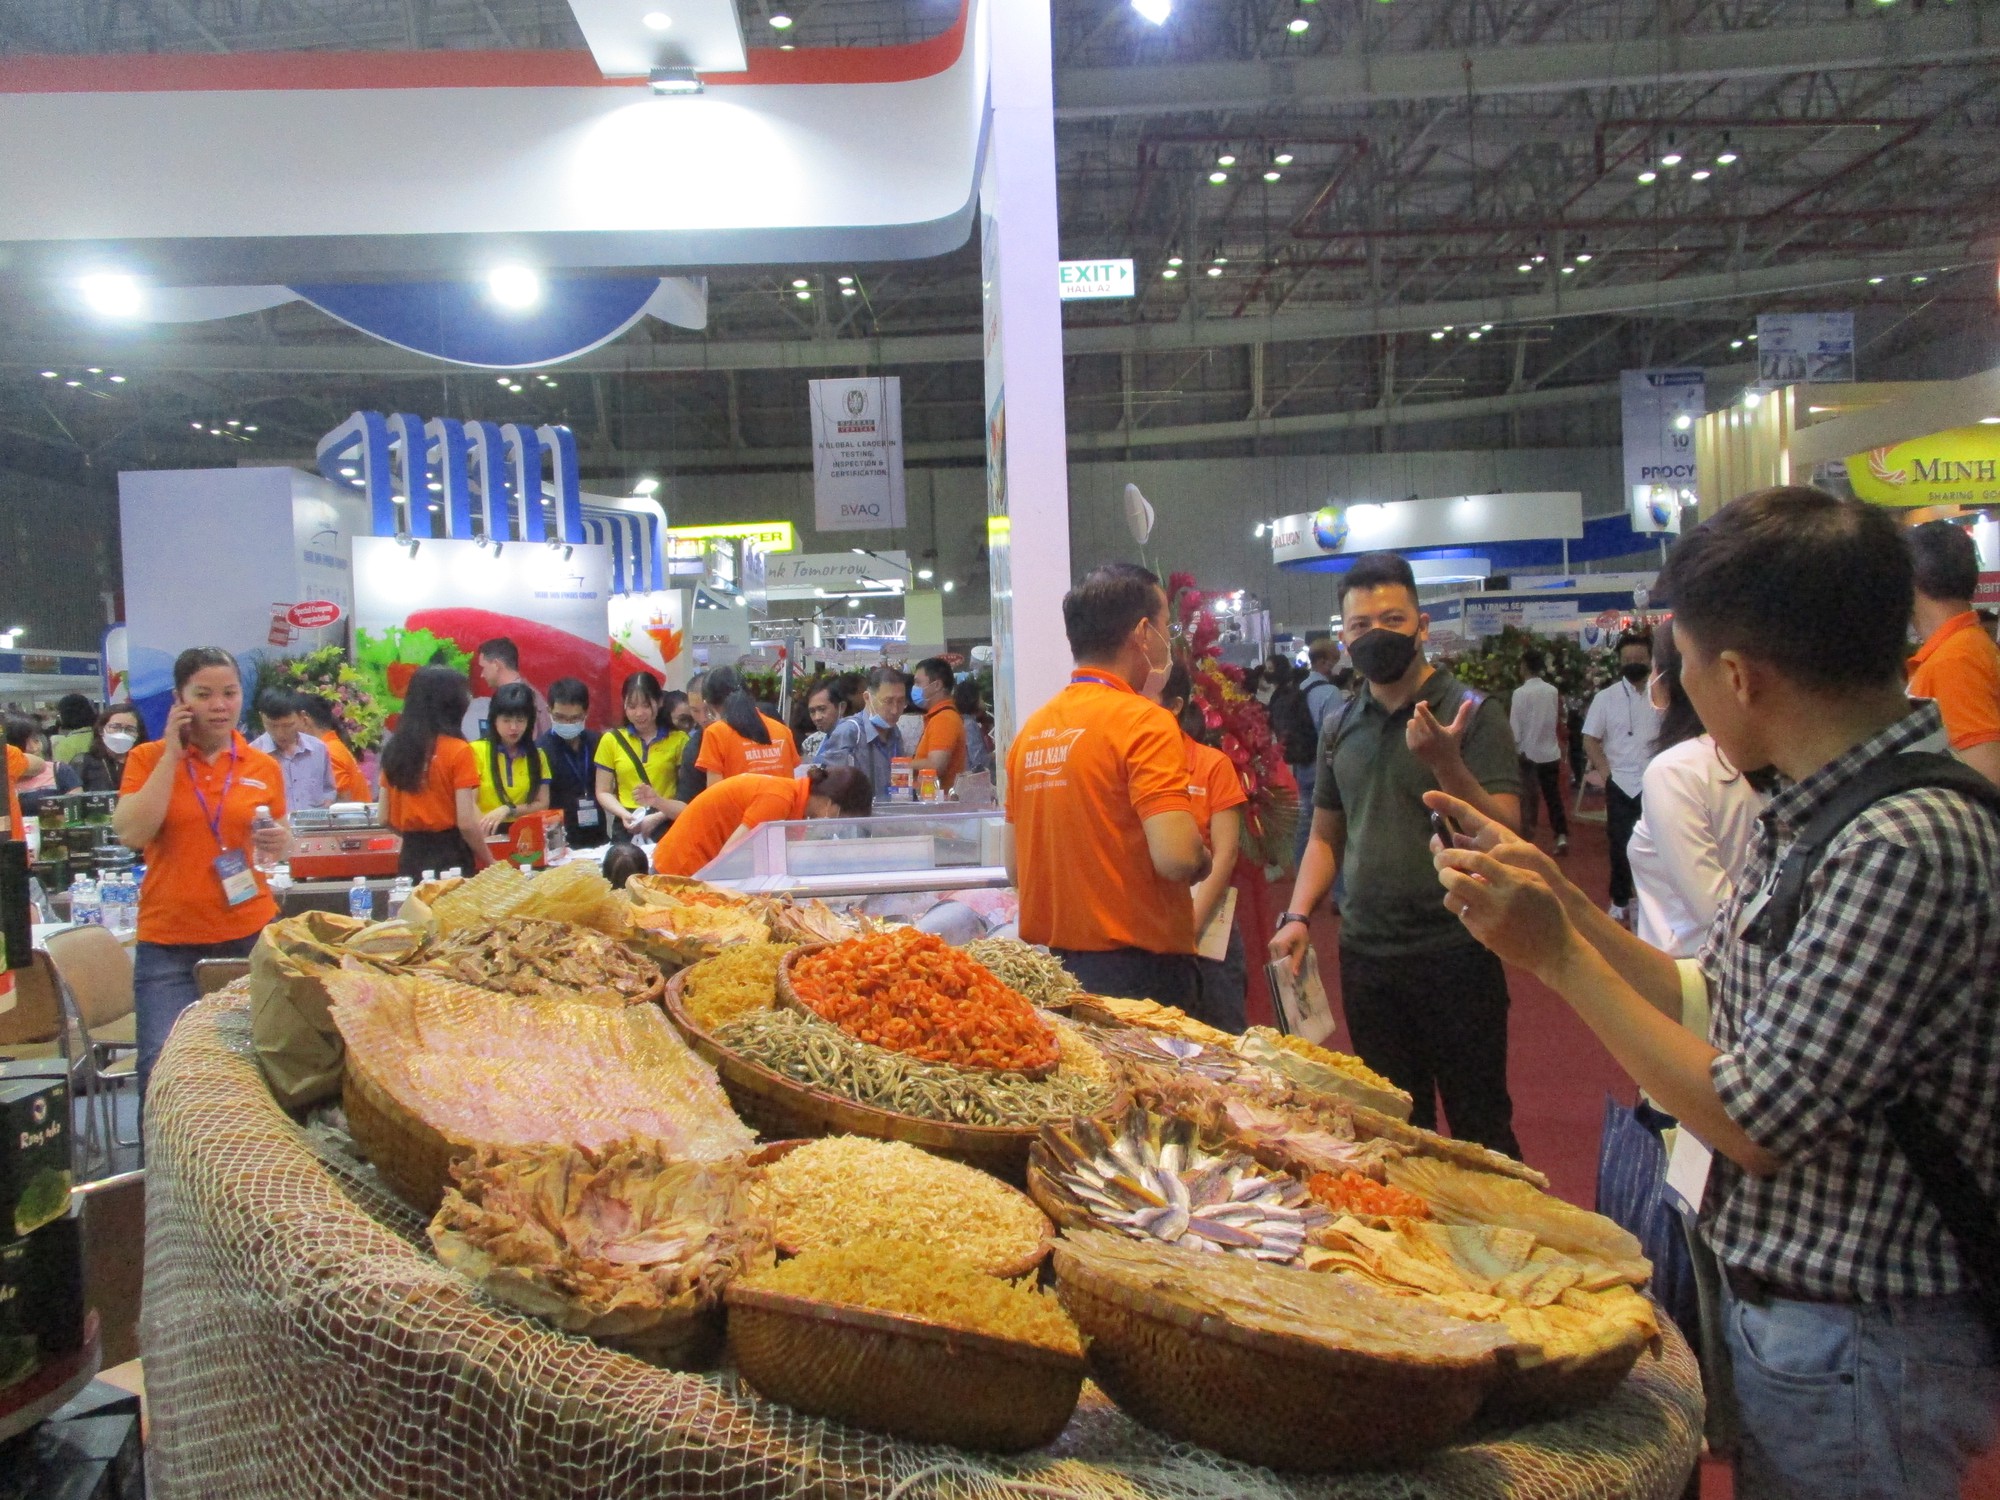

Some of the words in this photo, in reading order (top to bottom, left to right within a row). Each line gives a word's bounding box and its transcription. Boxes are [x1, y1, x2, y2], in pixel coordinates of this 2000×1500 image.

[1060, 265, 1114, 283] EXIT
[1067, 285, 1093, 293] HALL
[1097, 284, 1111, 292] A2
[826, 441, 855, 449] GLOBAL
[857, 440, 887, 448] LEADER
[833, 460, 877, 468] INSPECTION
[1911, 458, 1996, 483] MINH
[1929, 490, 1973, 501] SHARING
[841, 503, 880, 517] BVAQ
[793, 559, 870, 577] Tomorrow.
[1484, 602, 1506, 612] TRANG
[761, 747, 781, 759] NAM
[1045, 744, 1069, 764] NAM
